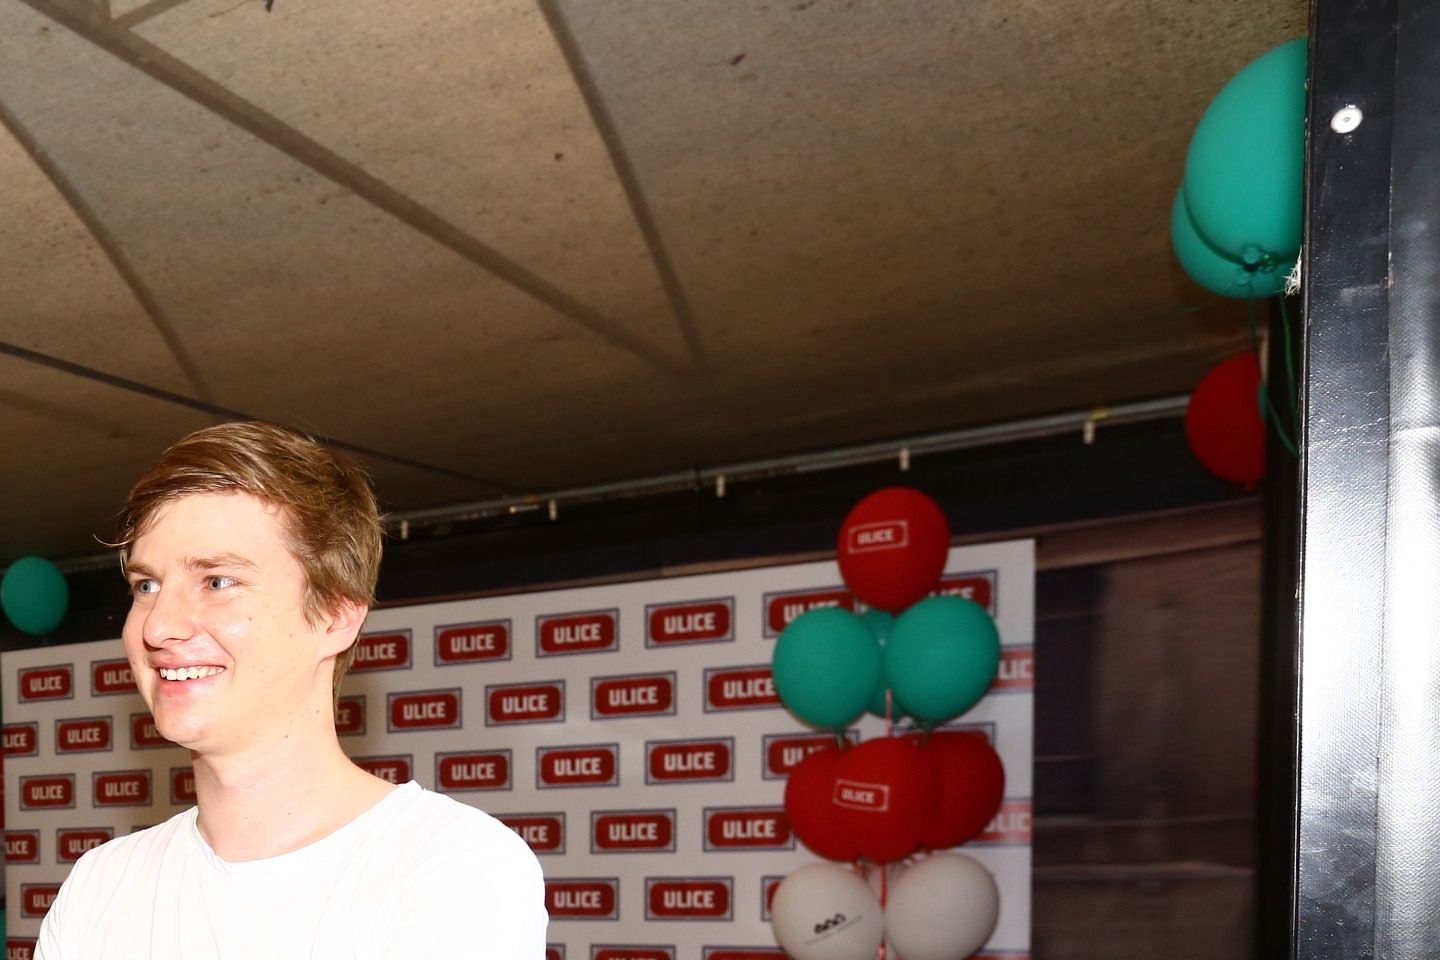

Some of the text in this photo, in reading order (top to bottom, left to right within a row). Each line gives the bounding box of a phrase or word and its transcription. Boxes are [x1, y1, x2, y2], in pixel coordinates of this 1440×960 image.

[859, 529, 895, 545] ULICE
[664, 613, 716, 634] ULICE
[553, 624, 601, 643] ULICE
[356, 643, 397, 661] ULICE
[451, 634, 495, 653] ULICE
[104, 669, 135, 685] ULIC
[998, 660, 1033, 679] LIC
[30, 676, 62, 692] ULICE
[723, 678, 775, 699] ULICE
[503, 695, 547, 713] ULICE
[609, 687, 657, 706] ULICE
[403, 702, 445, 720] ULICE
[4, 735, 27, 749] LICE
[67, 728, 100, 744] ULICE
[554, 758, 601, 776] ULICE
[664, 752, 715, 771] ULICE
[452, 764, 495, 780] ULICE
[31, 784, 63, 800] ULICE
[105, 781, 140, 796] ULICE
[841, 788, 875, 803] ULICE
[609, 823, 657, 841] ULICE
[723, 820, 775, 839] ULICE
[5, 840, 28, 854] LICE
[554, 891, 601, 908] ULICE
[664, 890, 714, 908] ULICE
[8, 947, 29, 960] LICE
